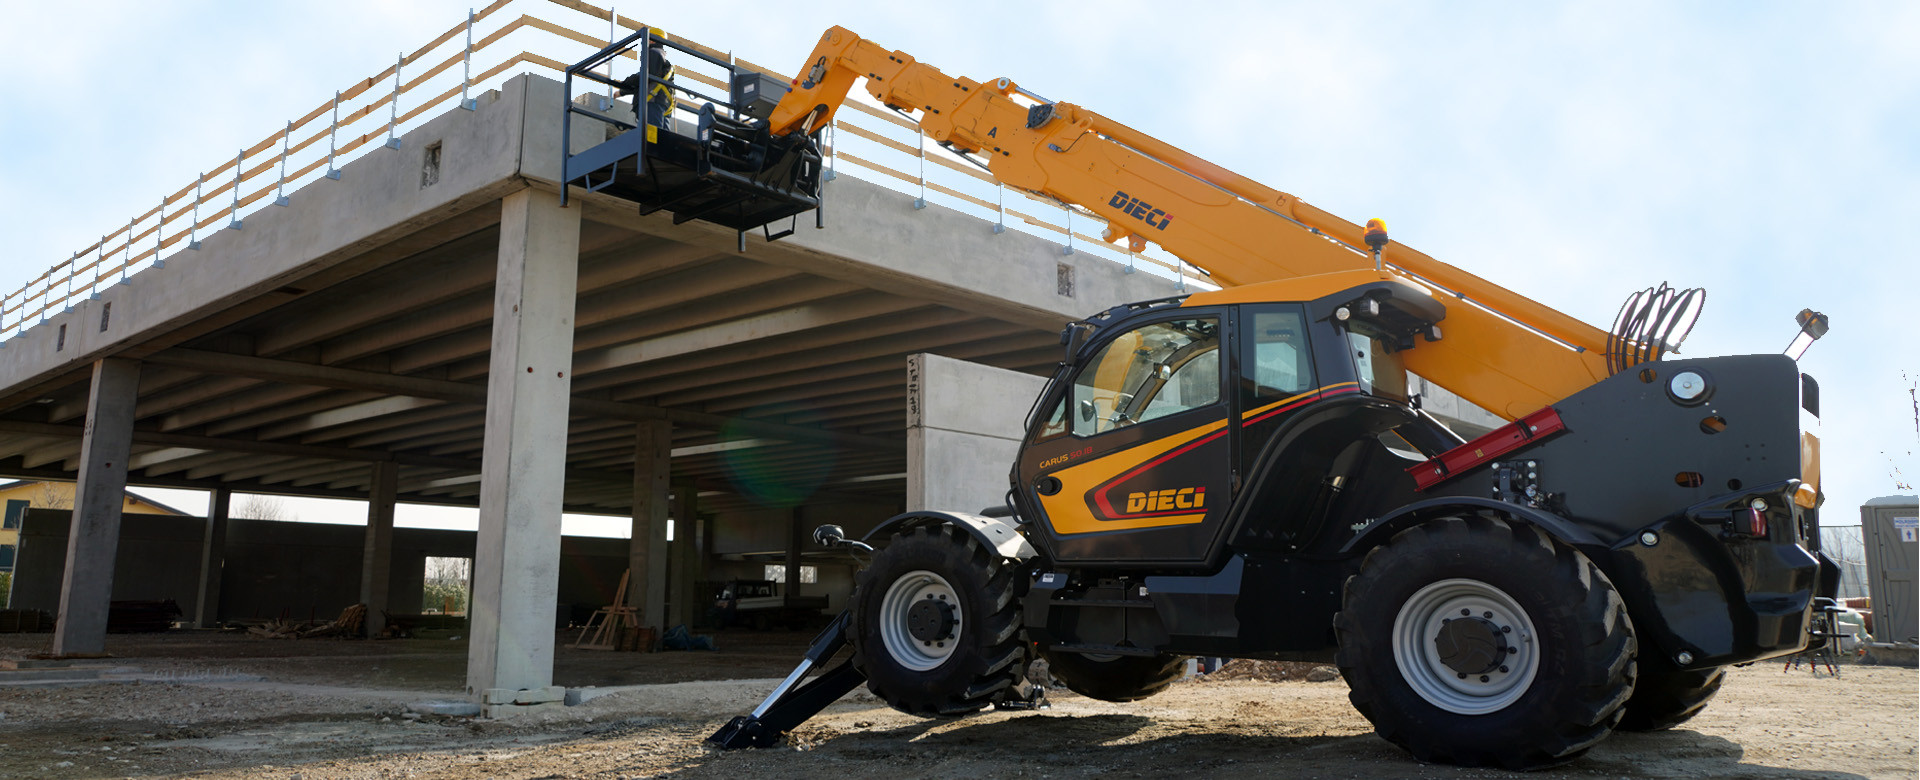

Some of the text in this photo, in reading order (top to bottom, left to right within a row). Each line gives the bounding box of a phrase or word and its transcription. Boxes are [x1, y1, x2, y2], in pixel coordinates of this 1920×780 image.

[987, 126, 998, 138] A
[1108, 190, 1174, 231] DIECI
[1039, 446, 1093, 469] CARUS 50.18
[1126, 486, 1206, 513] DIECI
